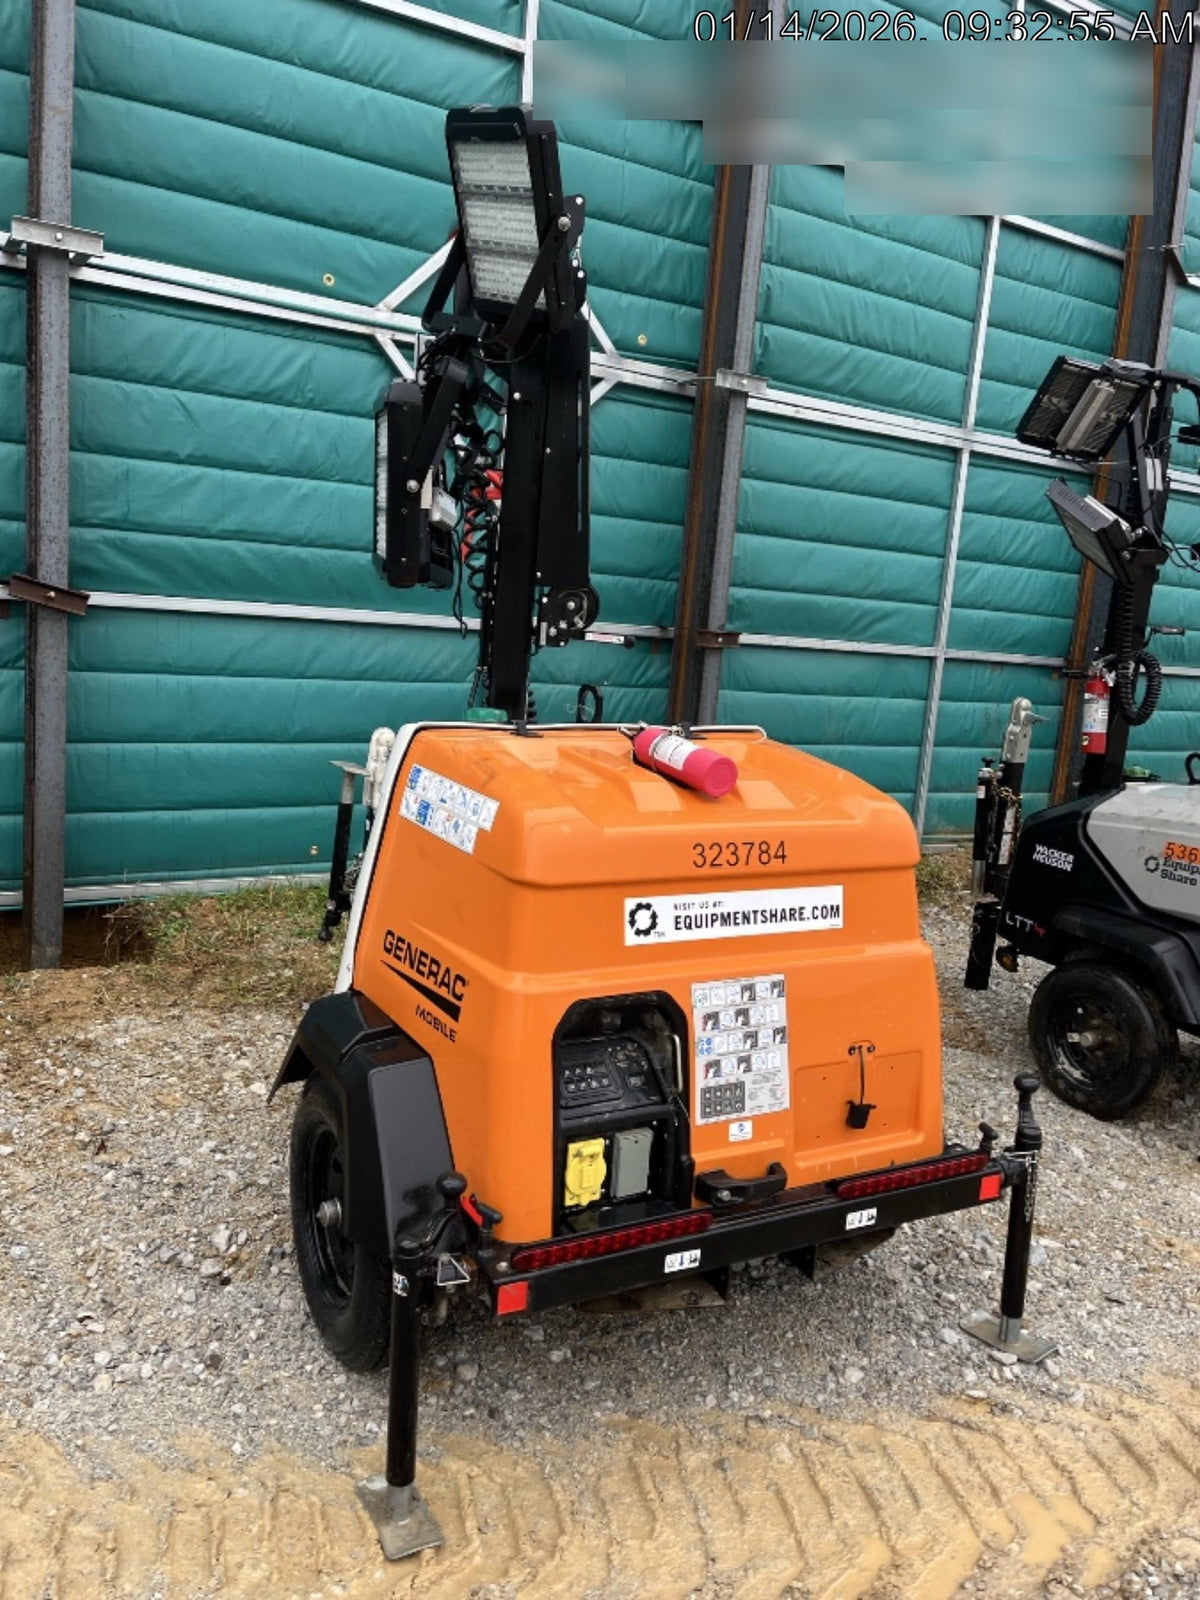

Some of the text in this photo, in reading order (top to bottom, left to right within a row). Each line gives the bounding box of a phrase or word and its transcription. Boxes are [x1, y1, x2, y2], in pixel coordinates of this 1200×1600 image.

[693, 840, 788, 869] 323784
[1032, 852, 1073, 872] NEUSON
[1035, 843, 1075, 863] WACKER
[1162, 857, 1200, 876] Equip
[1160, 868, 1198, 886] Share
[673, 902, 696, 911] VISIT
[699, 901, 710, 909] US
[674, 904, 841, 931] EQUIPMENTSHARE.COM
[383, 928, 467, 1001] GENERAC
[415, 1005, 457, 1042] MOBILE
